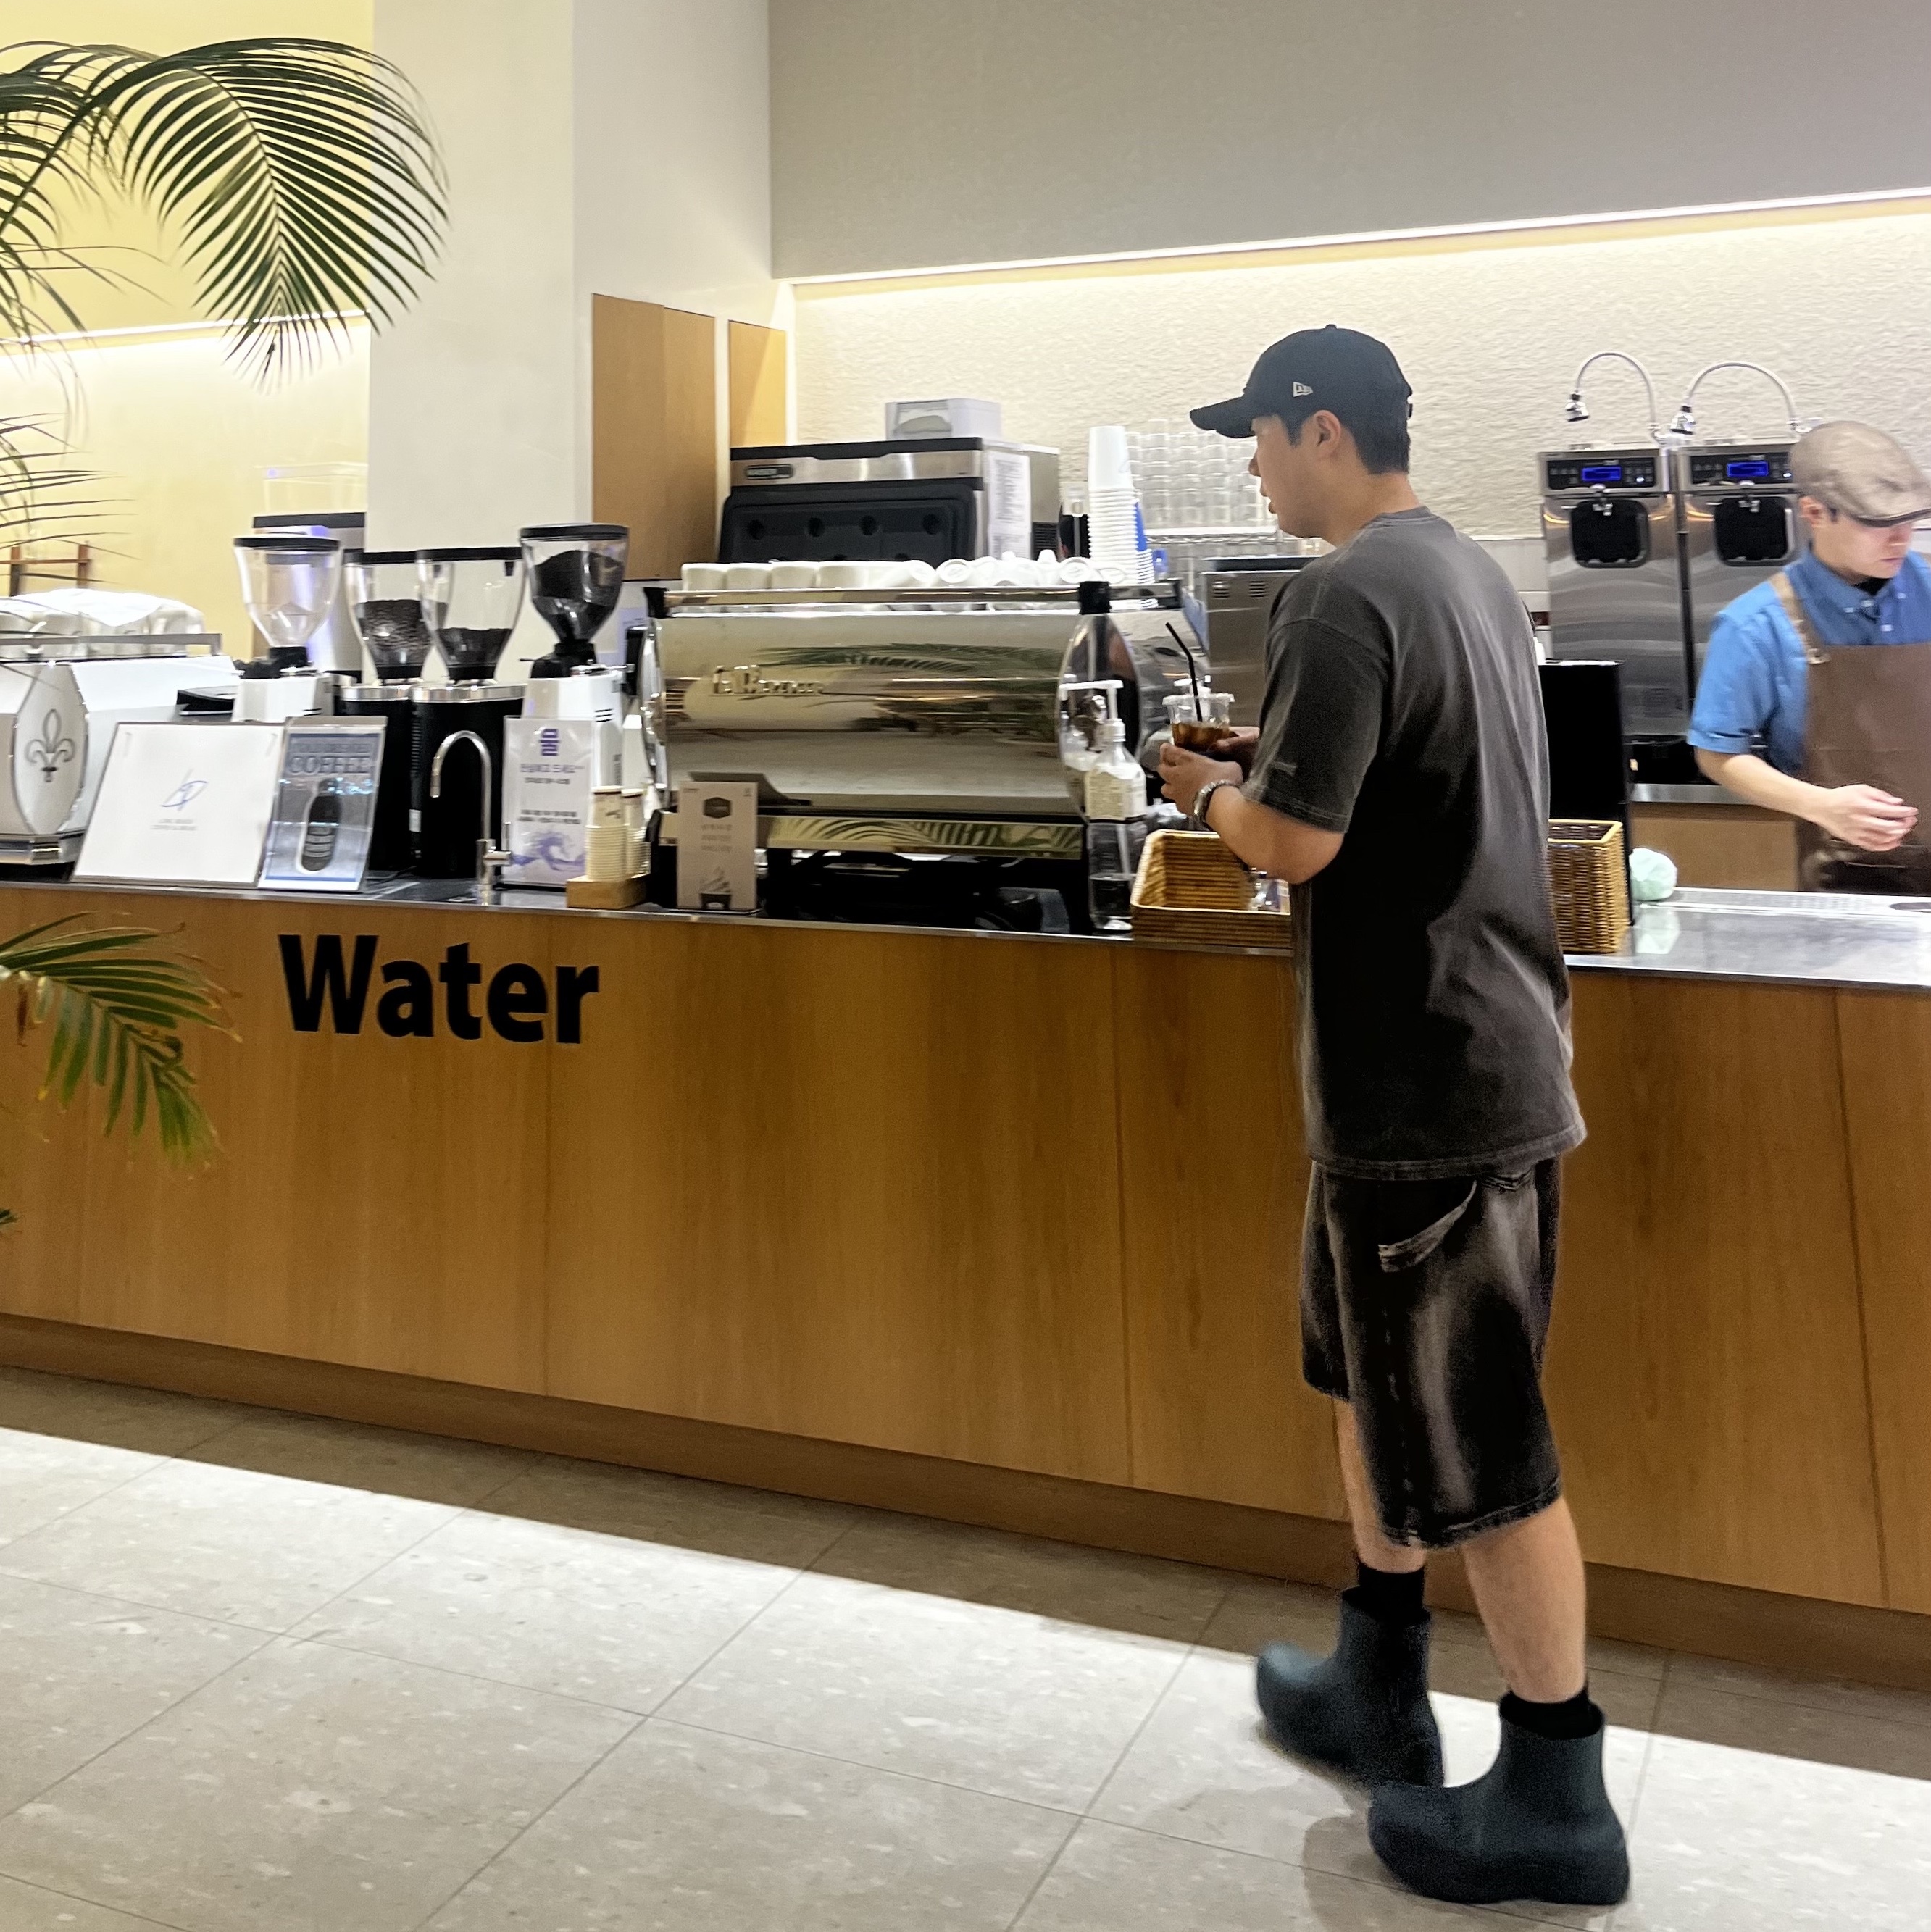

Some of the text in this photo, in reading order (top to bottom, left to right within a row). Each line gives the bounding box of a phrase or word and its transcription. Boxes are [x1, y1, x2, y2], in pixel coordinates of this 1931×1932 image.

[540, 728, 559, 756] 물
[289, 755, 370, 774] COFFEE
[278, 934, 599, 1045] Water
